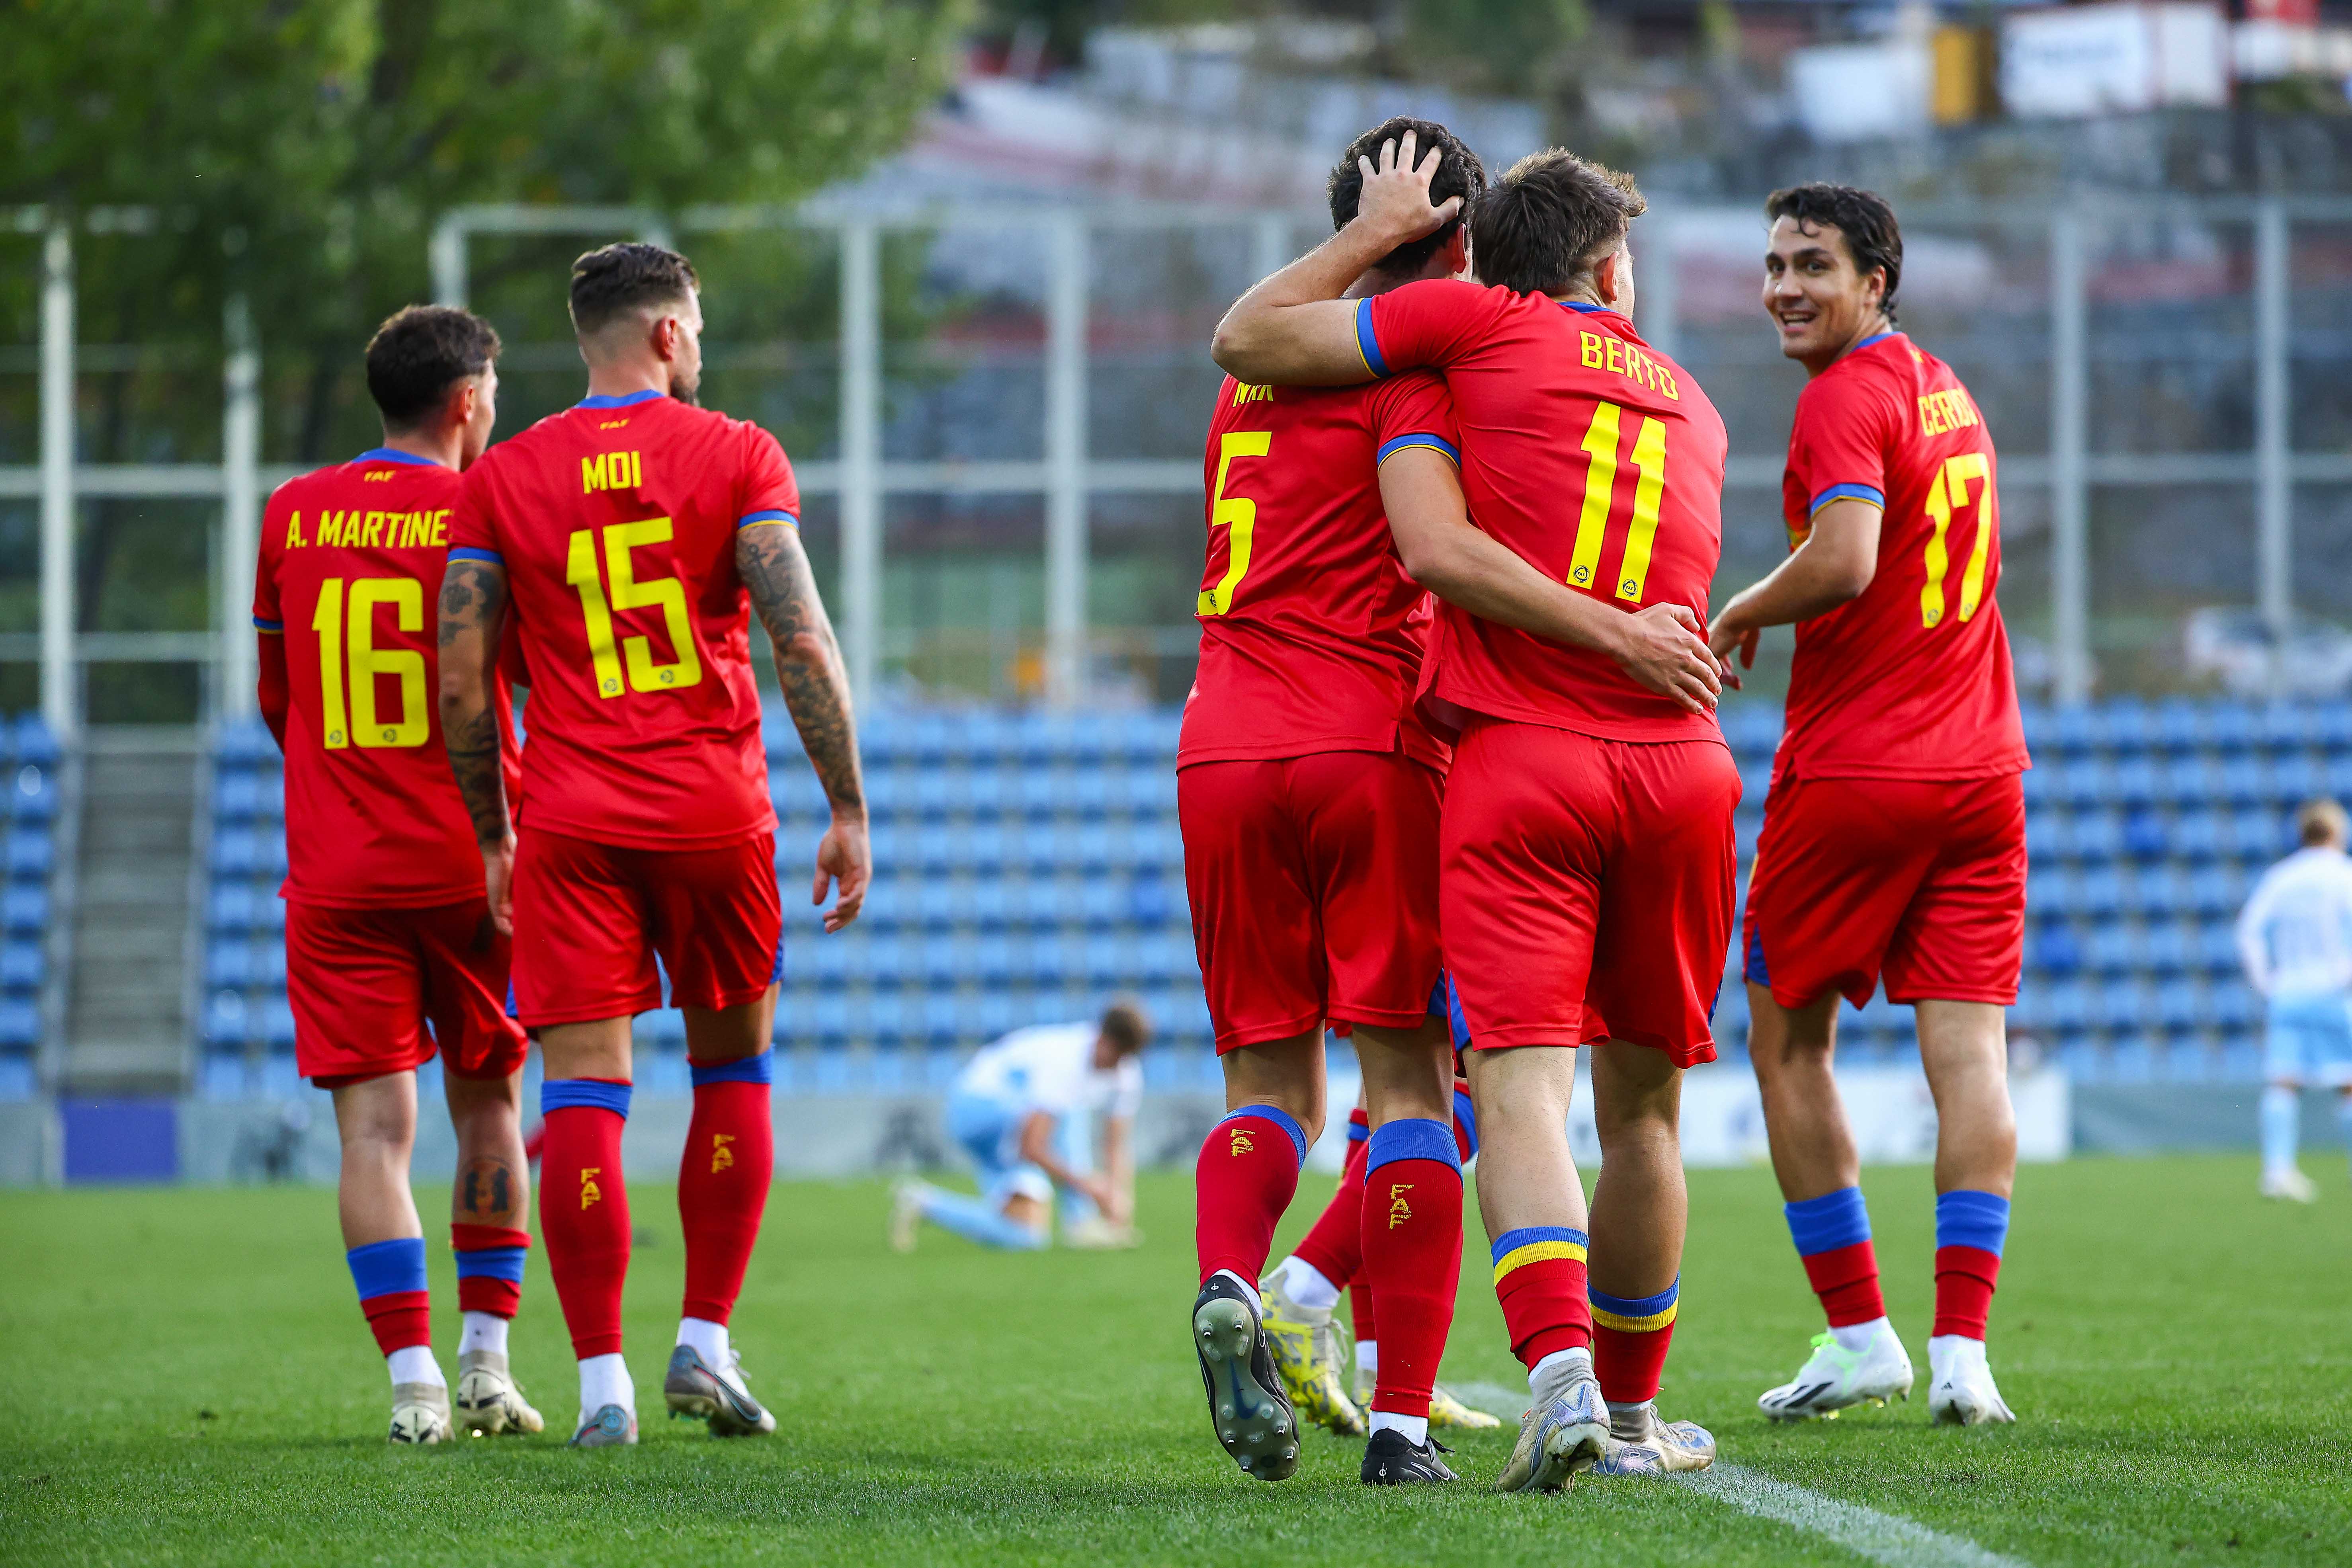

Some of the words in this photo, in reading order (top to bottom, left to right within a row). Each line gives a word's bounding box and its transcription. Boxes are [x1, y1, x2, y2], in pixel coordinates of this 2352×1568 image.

[1580, 330, 1680, 401] BERTO
[285, 510, 308, 549] A.
[316, 509, 454, 548] MARTINE
[581, 450, 642, 494] MOI
[1197, 431, 1272, 616] 5
[1566, 400, 1667, 604] 11
[1920, 452, 1993, 629] 17
[312, 578, 429, 749] 16
[567, 516, 702, 699] 15
[1389, 1184, 1414, 1230] FAF
